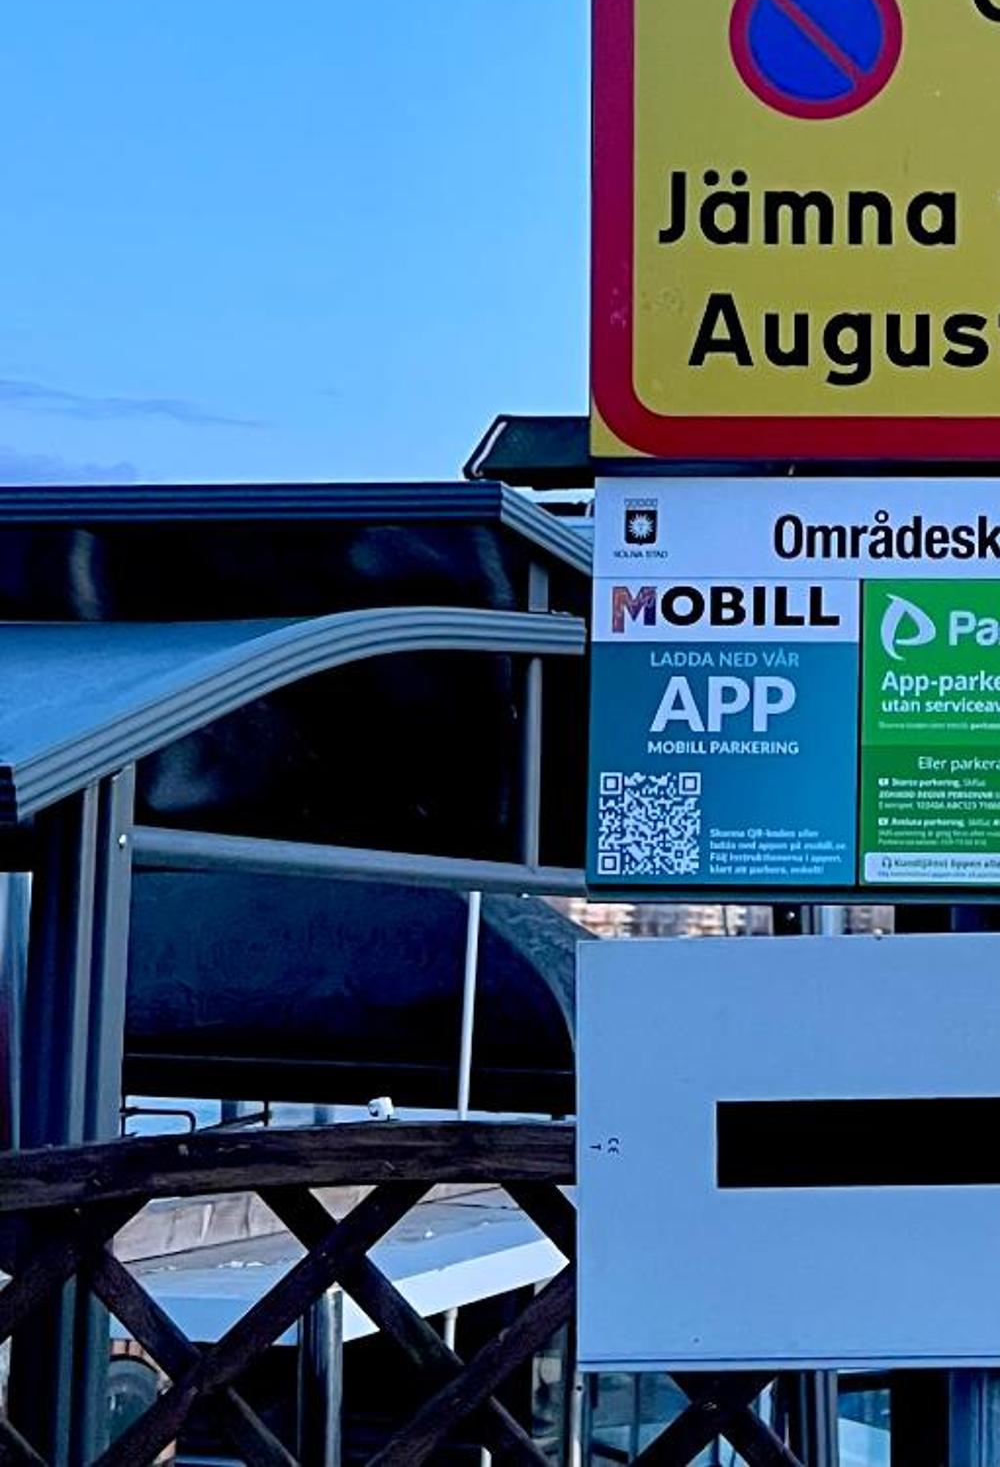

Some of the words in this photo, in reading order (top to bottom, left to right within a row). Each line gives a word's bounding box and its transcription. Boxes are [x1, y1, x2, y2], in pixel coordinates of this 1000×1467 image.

[658, 169, 957, 247] Jämna
[612, 585, 841, 634] MOBILL
[650, 651, 715, 668] LADDA
[719, 651, 758, 668] NED
[761, 647, 800, 668] VÅR
[649, 675, 798, 733] APP
[881, 698, 921, 713] utan
[647, 740, 707, 755] MOBILL
[709, 740, 800, 755] PARKERING
[917, 755, 948, 770] Eller
